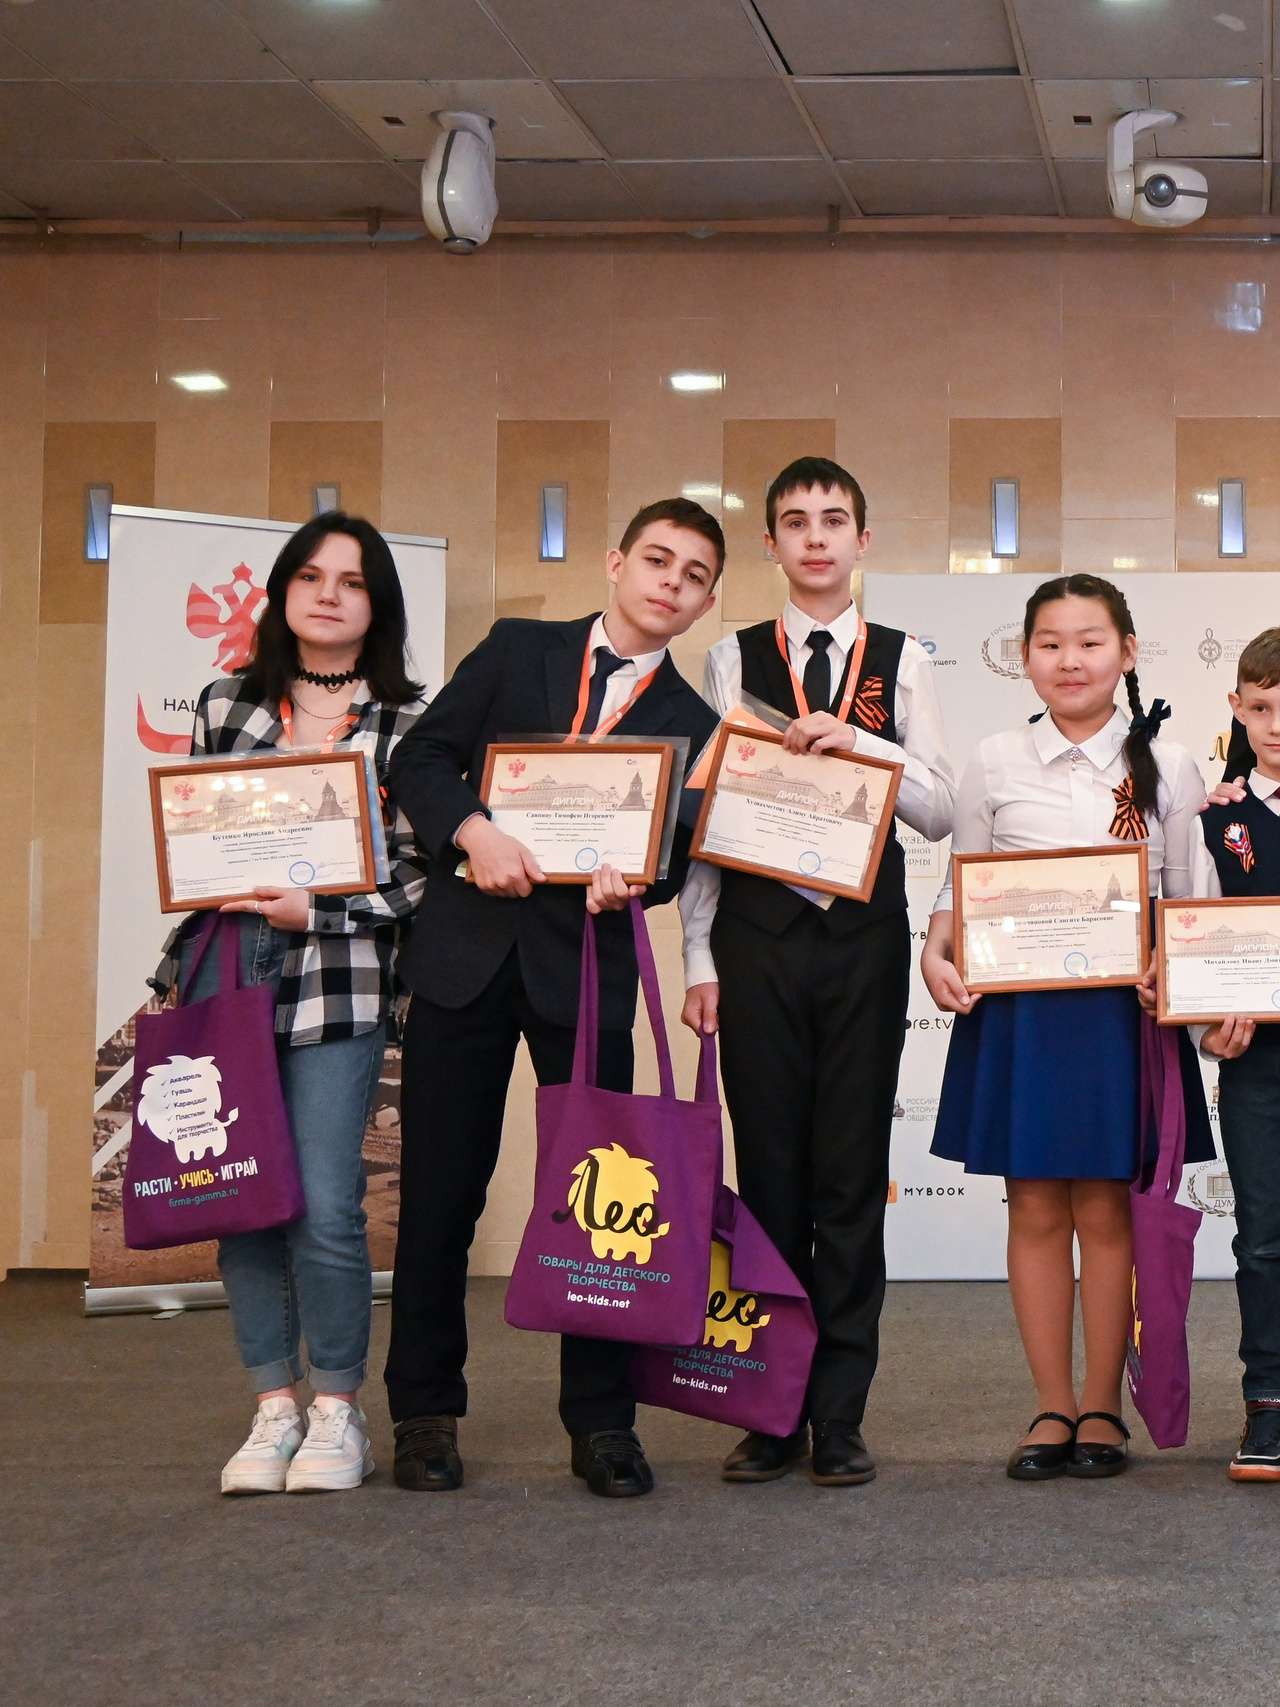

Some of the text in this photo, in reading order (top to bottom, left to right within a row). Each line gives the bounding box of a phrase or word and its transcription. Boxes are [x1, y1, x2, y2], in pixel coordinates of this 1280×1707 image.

[932, 659, 957, 667] ущего
[1007, 662, 1023, 671] ДУ
[551, 796, 595, 806] ДИПЛОМ
[775, 790, 819, 806] ДИПЛОМ
[1028, 901, 1074, 912] ДИПЛОМ
[1233, 943, 1279, 954] ДИПЛОМ
[169, 1072, 202, 1085] Акварель
[171, 1087, 193, 1097] Гуашь
[173, 1096, 208, 1109] Карандаши
[175, 1110, 206, 1121] Пластилин
[176, 1120, 214, 1134] Инструменты
[188, 1126, 219, 1139] творчества
[134, 1156, 259, 1198] РАСТИ УЧИСЬ ИГРАЙ
[168, 1187, 239, 1208] firma-gamma.ru
[904, 1187, 965, 1196] MYBOOK
[1214, 1199, 1237, 1208] ДУМ
[537, 1254, 671, 1284] ТОВАРЫ ДЛЯ ДЕТСКОГО
[567, 1273, 637, 1293] ТВОРЧЕСТВА
[566, 1290, 631, 1309] leo-kids.net
[688, 1347, 712, 1360] ДЛЯ
[713, 1352, 767, 1372] ДЕТСКОГО
[672, 1357, 734, 1379] ТВОРЧЕСТВА
[672, 1373, 728, 1394] leo-kids.net
